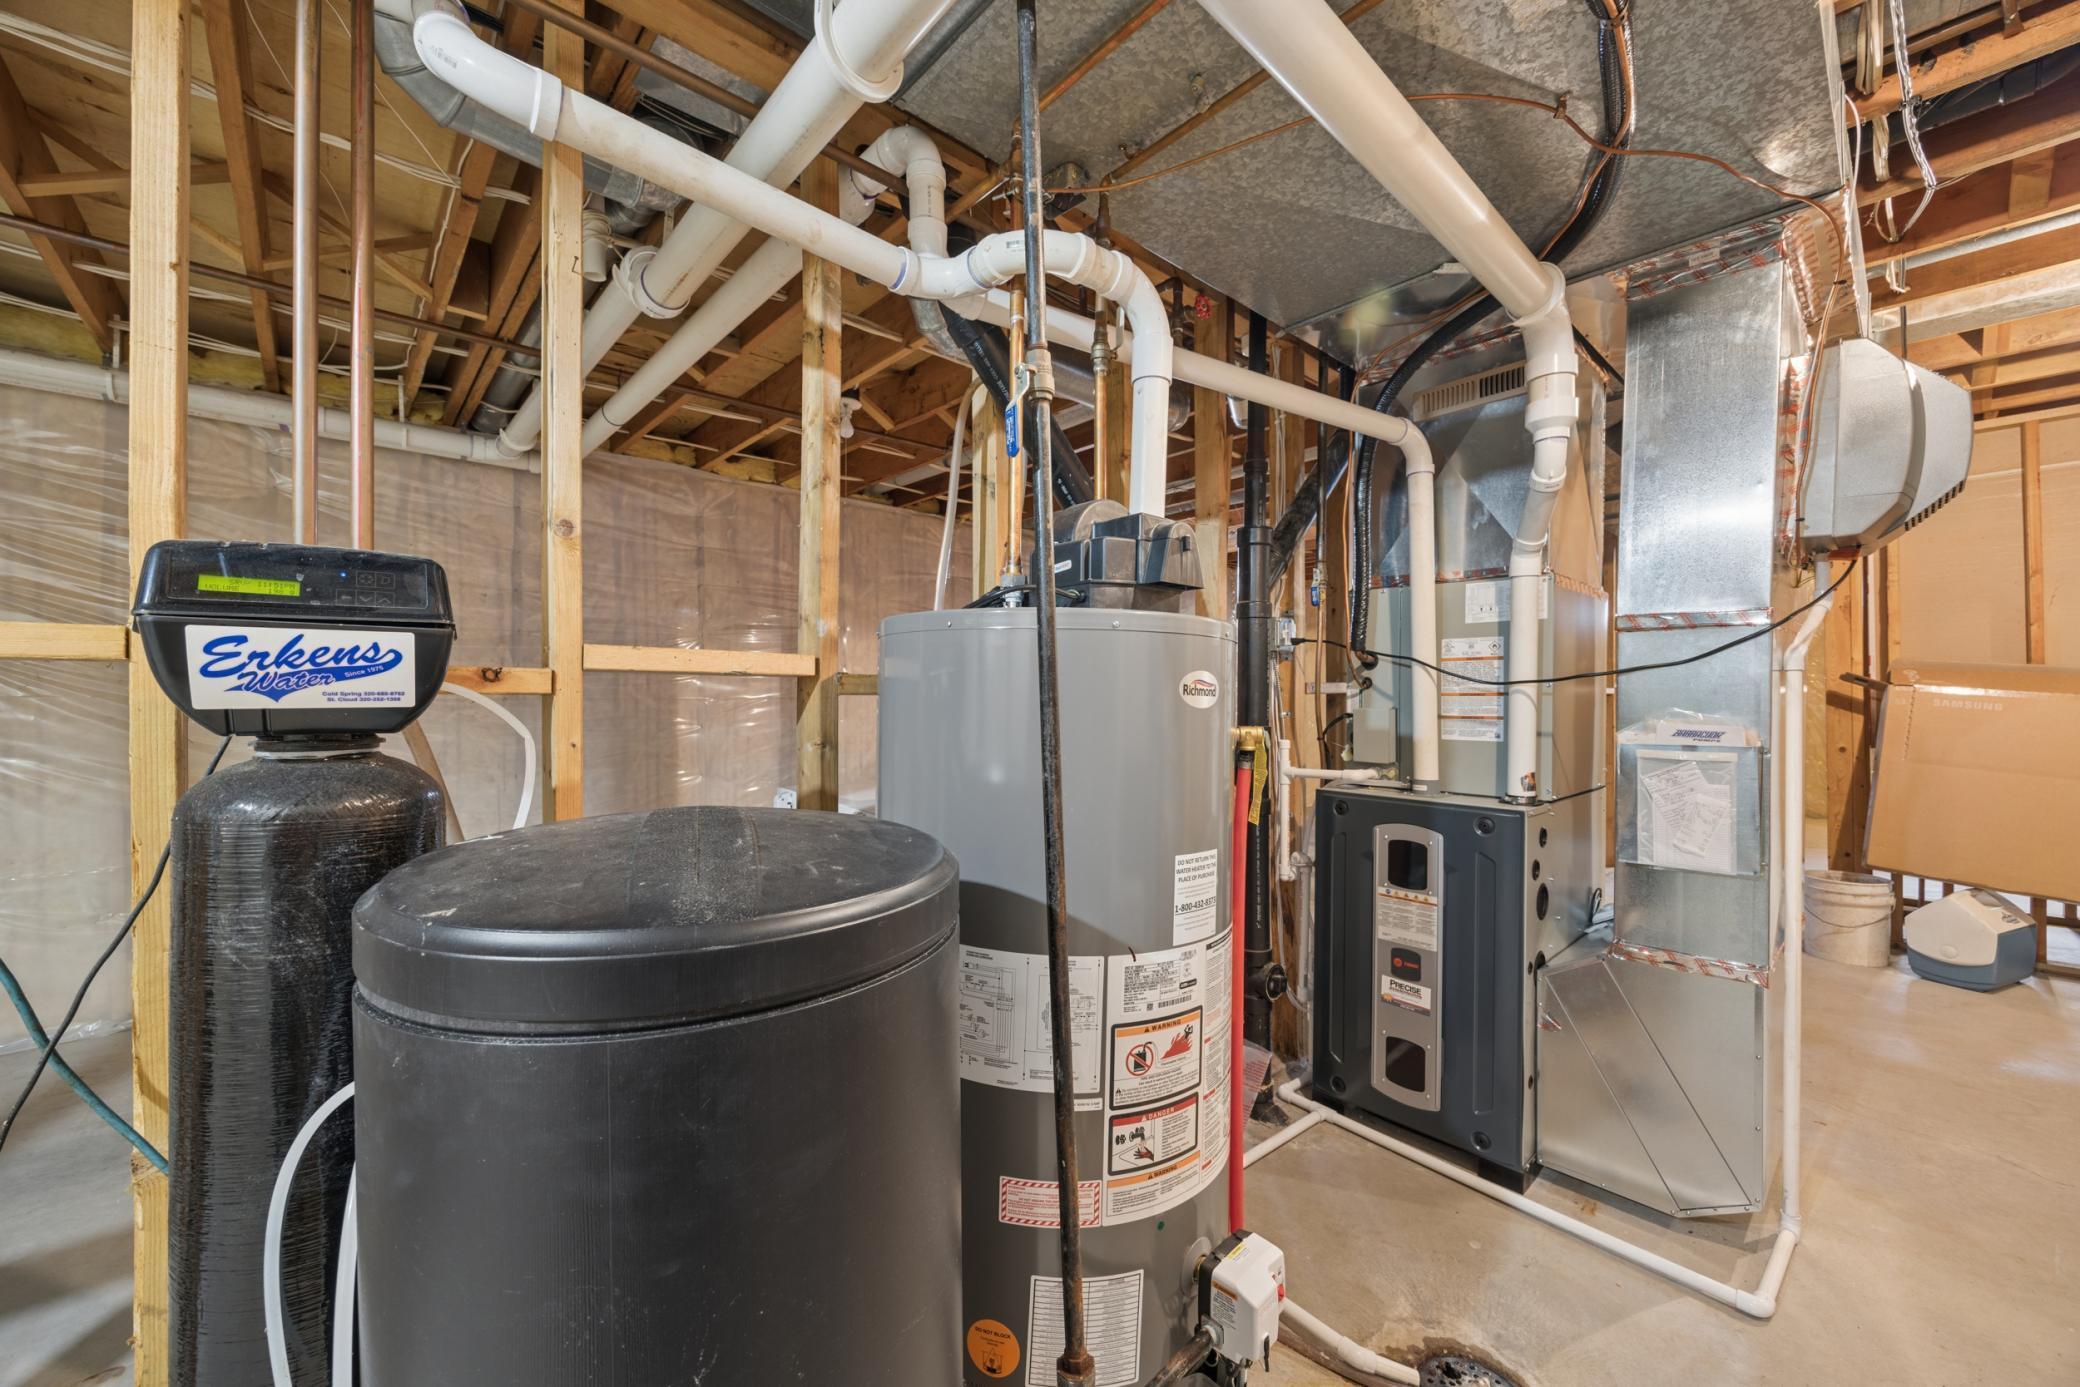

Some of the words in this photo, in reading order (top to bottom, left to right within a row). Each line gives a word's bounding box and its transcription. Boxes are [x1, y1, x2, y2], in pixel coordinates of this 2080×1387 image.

[199, 634, 400, 678] Erkens
[344, 669, 366, 678] Since
[237, 670, 336, 692] Water
[1182, 683, 1217, 698] Richmond
[1933, 698, 2003, 711] SAMSUNG
[1176, 867, 1191, 875] WATER
[1192, 864, 1205, 873] HEATER
[1178, 875, 1191, 883] PLACE
[1390, 979, 1422, 995] PRECISE
[1152, 1019, 1182, 1032] WARNING
[1148, 1106, 1175, 1120] DANGER
[1154, 1164, 1178, 1178] WARNING
[994, 1331, 1011, 1340] BLOCK
